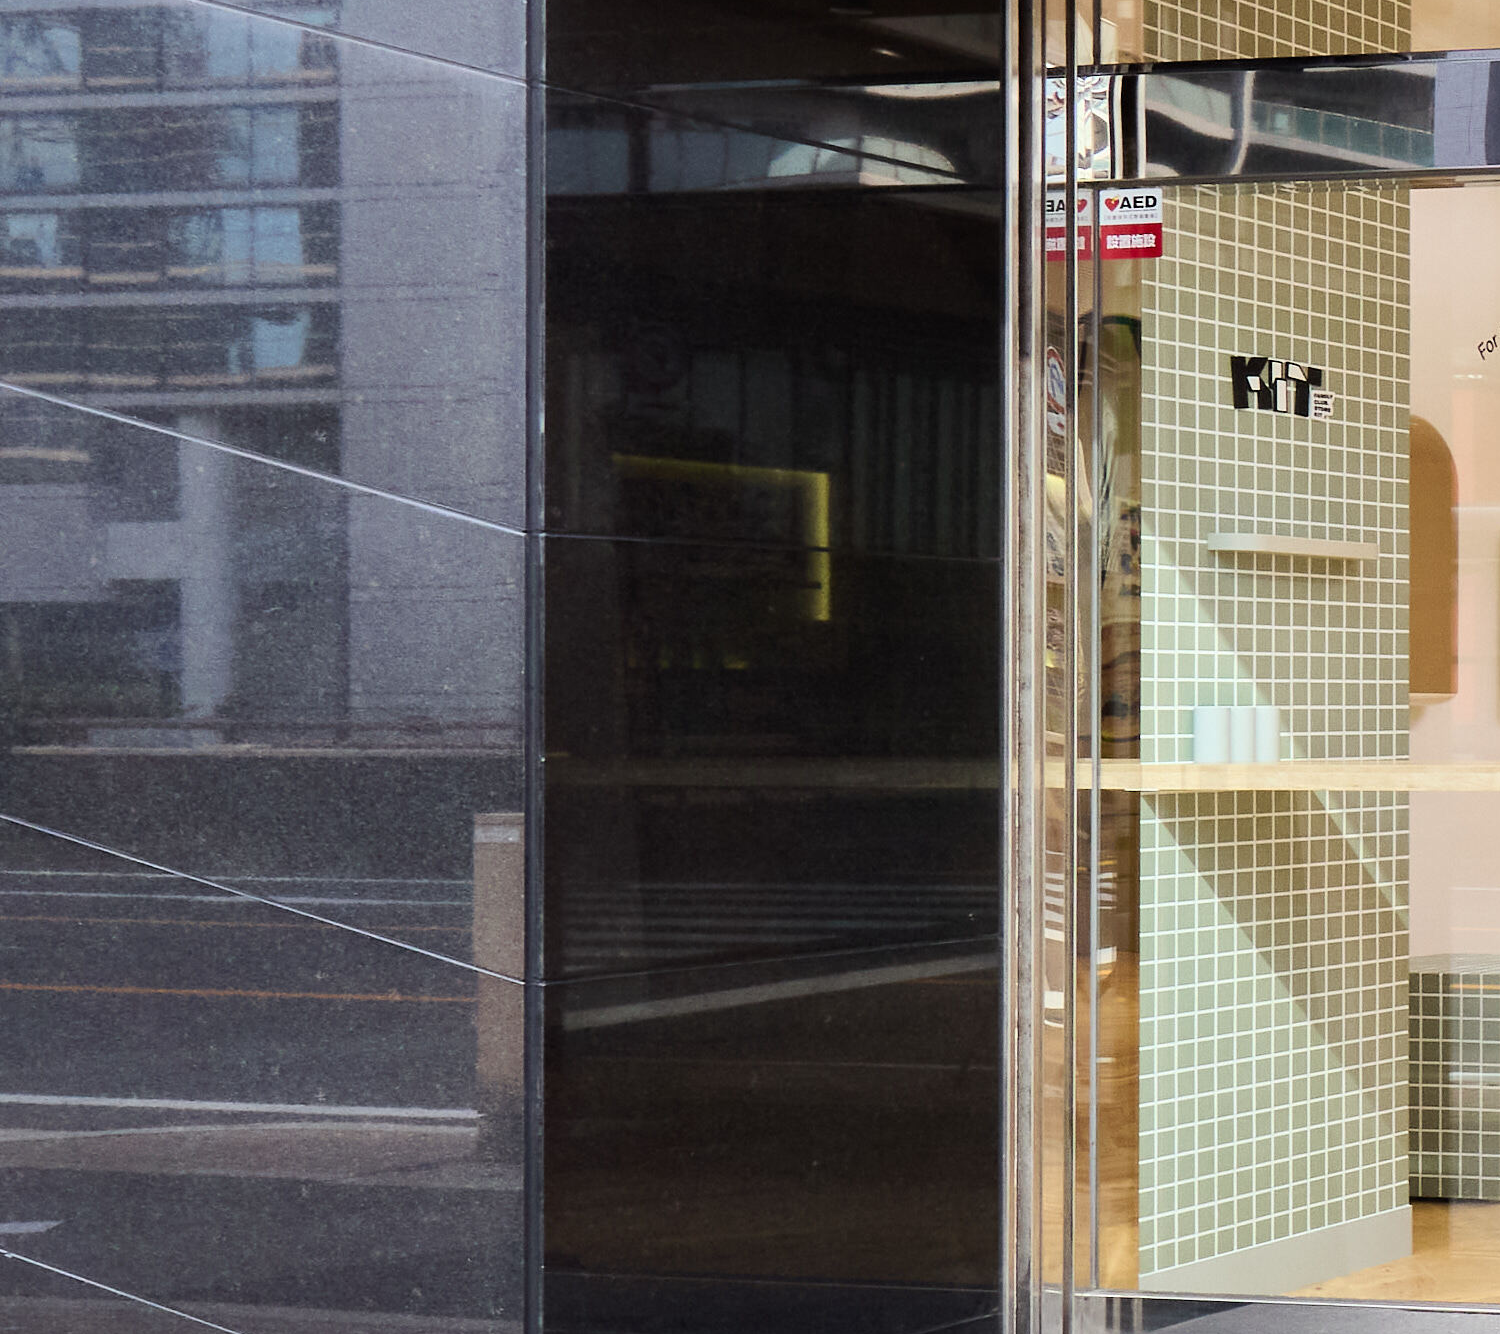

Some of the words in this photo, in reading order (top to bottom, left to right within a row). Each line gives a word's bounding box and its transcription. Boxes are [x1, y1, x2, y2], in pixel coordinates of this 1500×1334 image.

[1120, 195, 1157, 209] AED
[1106, 233, 1156, 249] 設置施設
[1477, 335, 1499, 360] For
[1230, 356, 1322, 418] KIT
